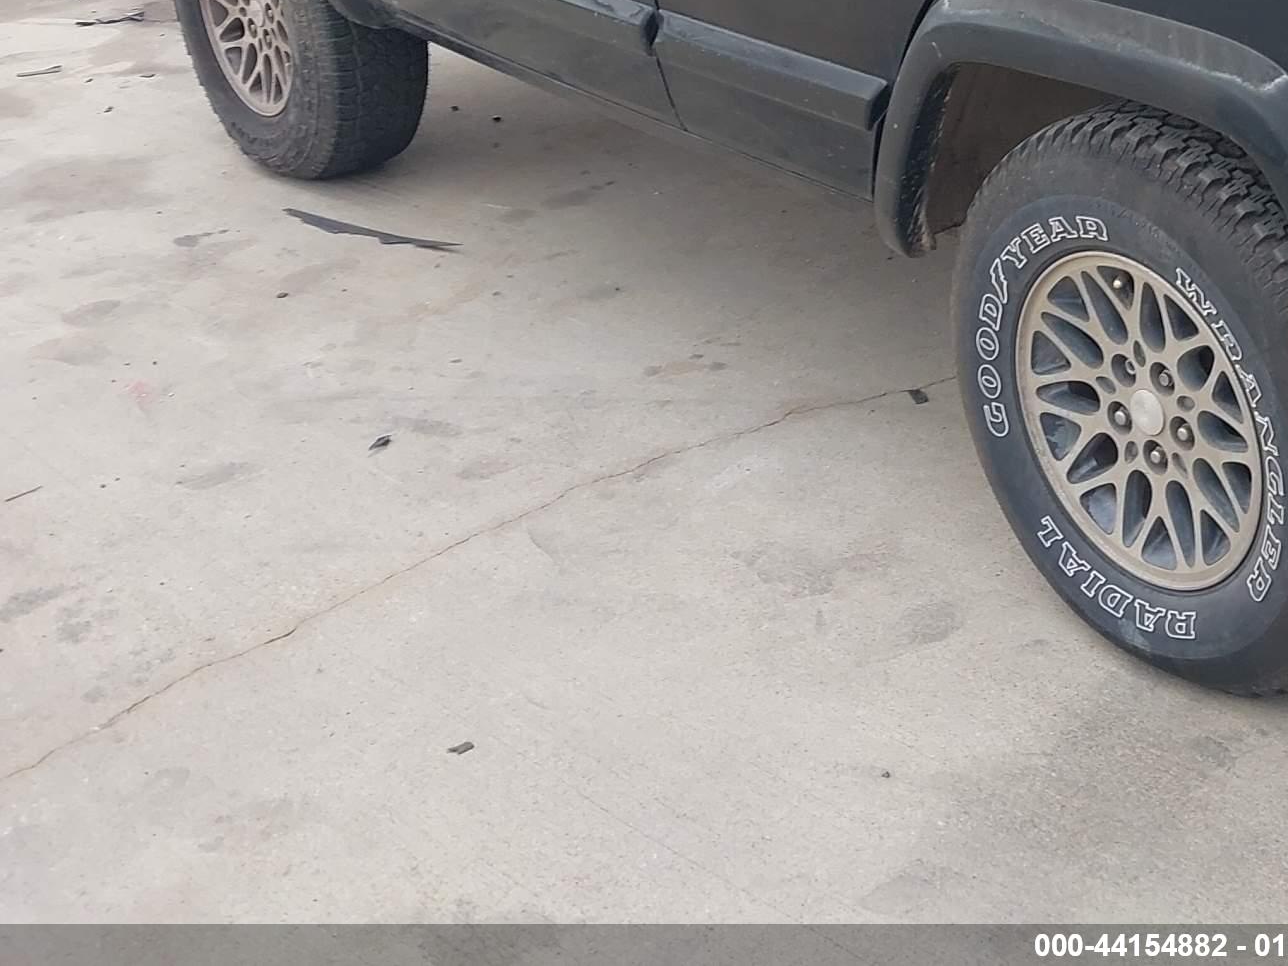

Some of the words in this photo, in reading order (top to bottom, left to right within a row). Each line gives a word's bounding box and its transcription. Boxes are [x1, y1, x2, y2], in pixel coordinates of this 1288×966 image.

[975, 215, 1109, 438] GOODYEAR
[1174, 267, 1287, 603] WRANGLER
[1037, 516, 1197, 641] RADIAL
